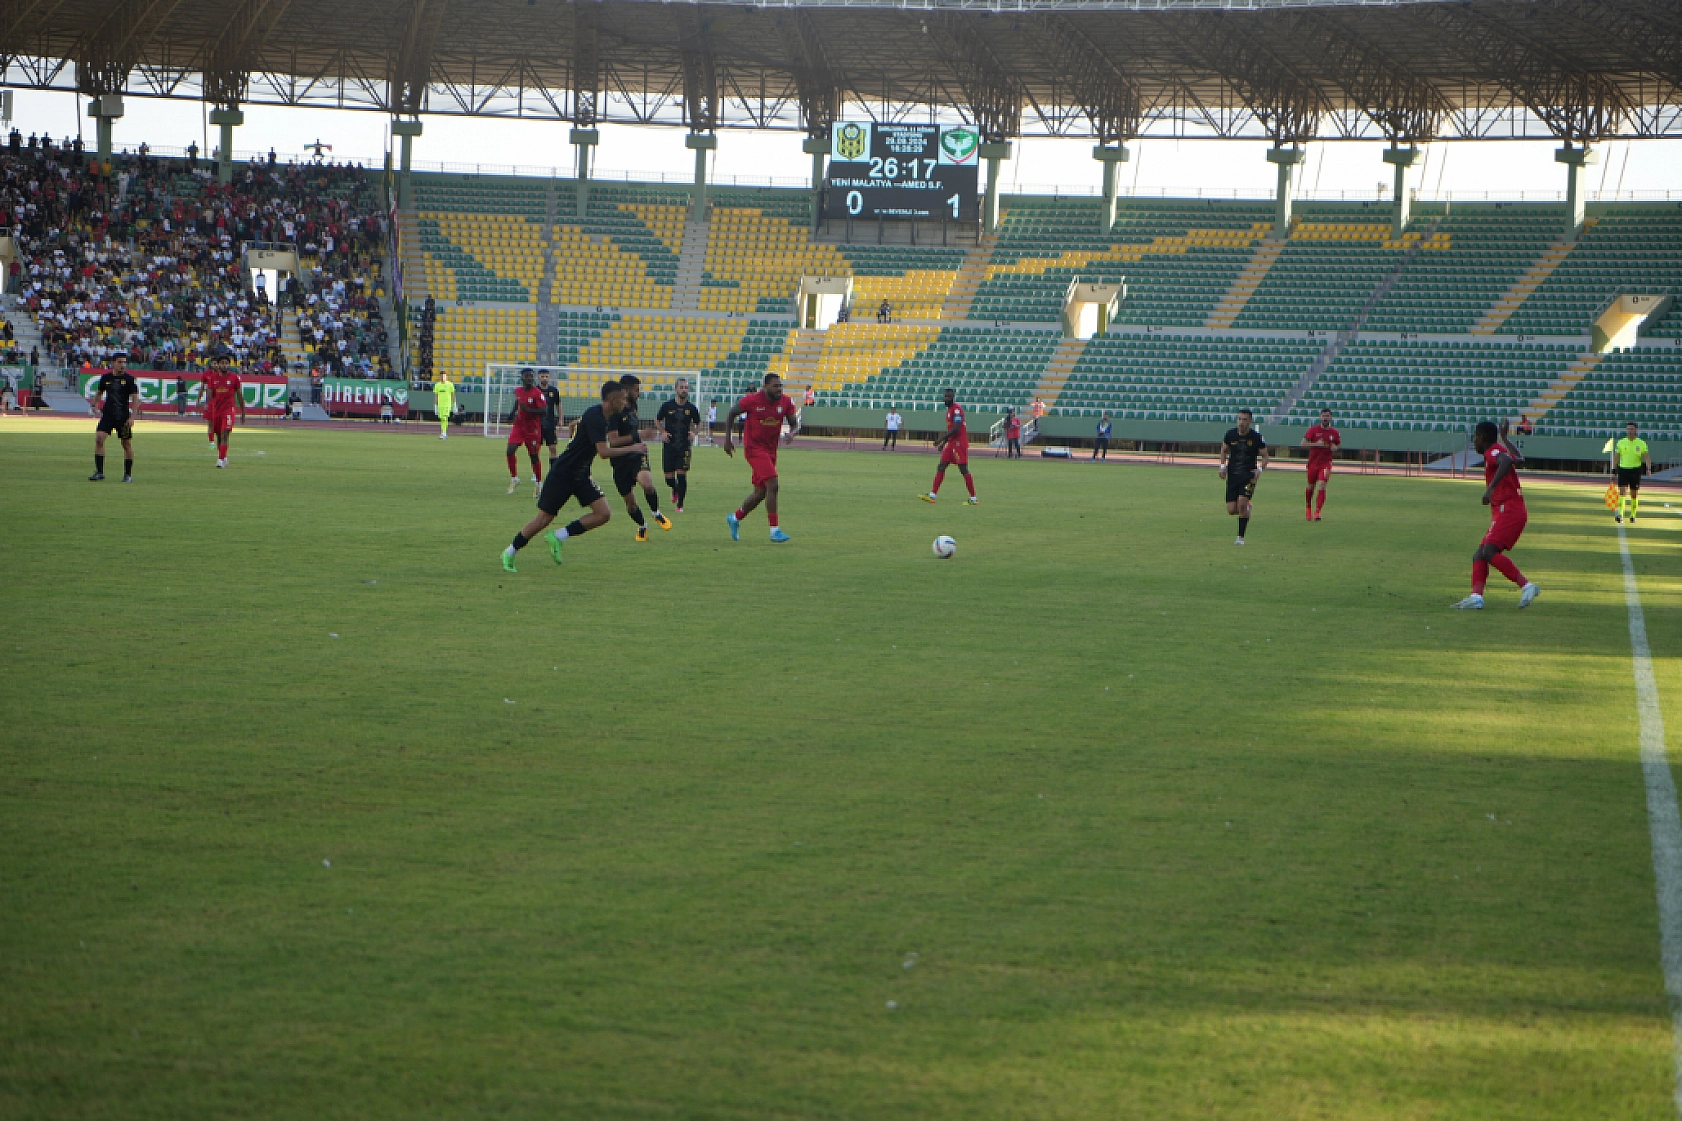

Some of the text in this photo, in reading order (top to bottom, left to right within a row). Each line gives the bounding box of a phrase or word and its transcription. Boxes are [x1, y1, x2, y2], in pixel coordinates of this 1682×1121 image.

[868, 156, 938, 180] 26:17
[851, 179, 892, 188] MALATYA
[846, 190, 961, 219] 0 1
